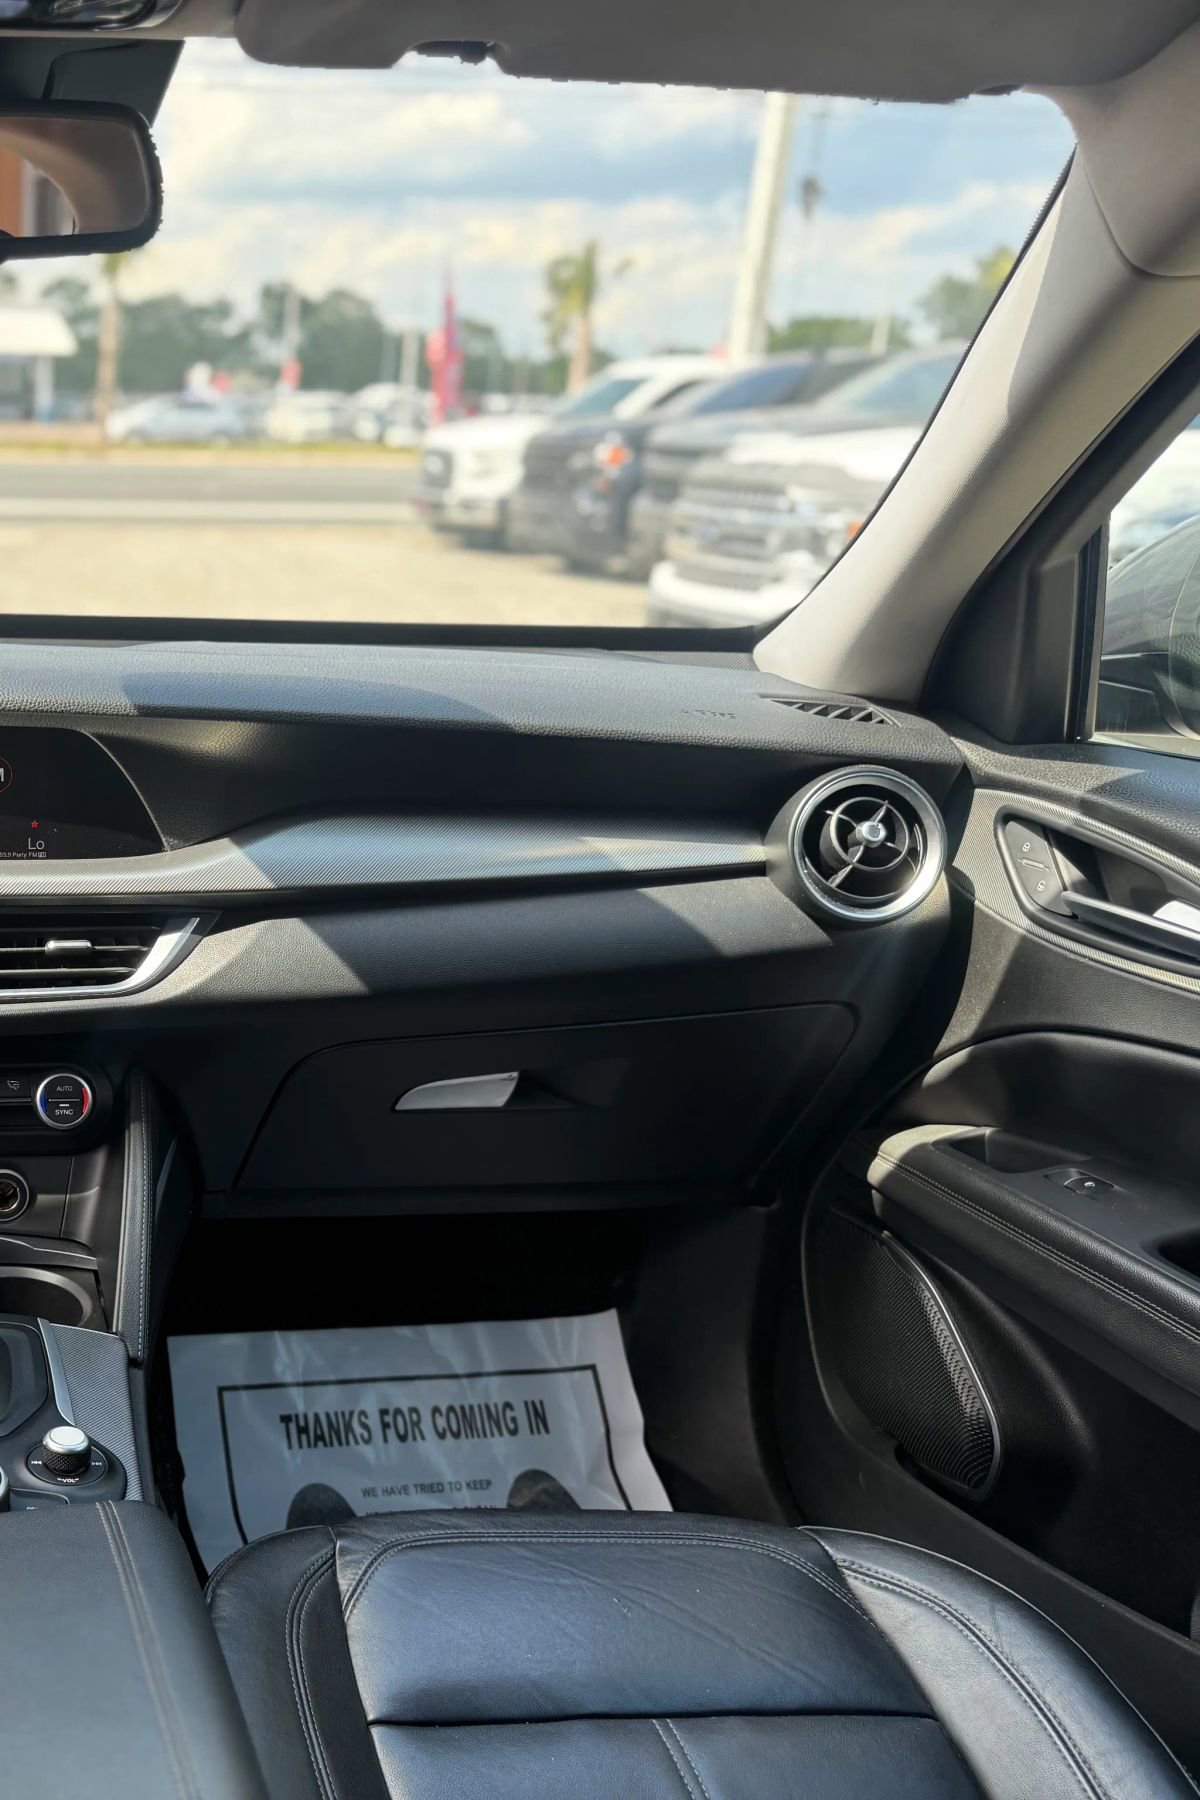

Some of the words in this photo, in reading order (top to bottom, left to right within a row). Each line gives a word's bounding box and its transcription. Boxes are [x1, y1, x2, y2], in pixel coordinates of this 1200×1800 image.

[28, 837, 45, 850] Lo
[279, 1408, 373, 1450] THANKS
[378, 1406, 426, 1444] FOR
[430, 1400, 519, 1441] COMING
[523, 1399, 551, 1436] IN
[361, 1486, 378, 1498] WE
[381, 1484, 409, 1497] HAVE
[412, 1482, 445, 1495] TRIED
[447, 1481, 462, 1492] TO
[465, 1479, 492, 1490] KEEP
